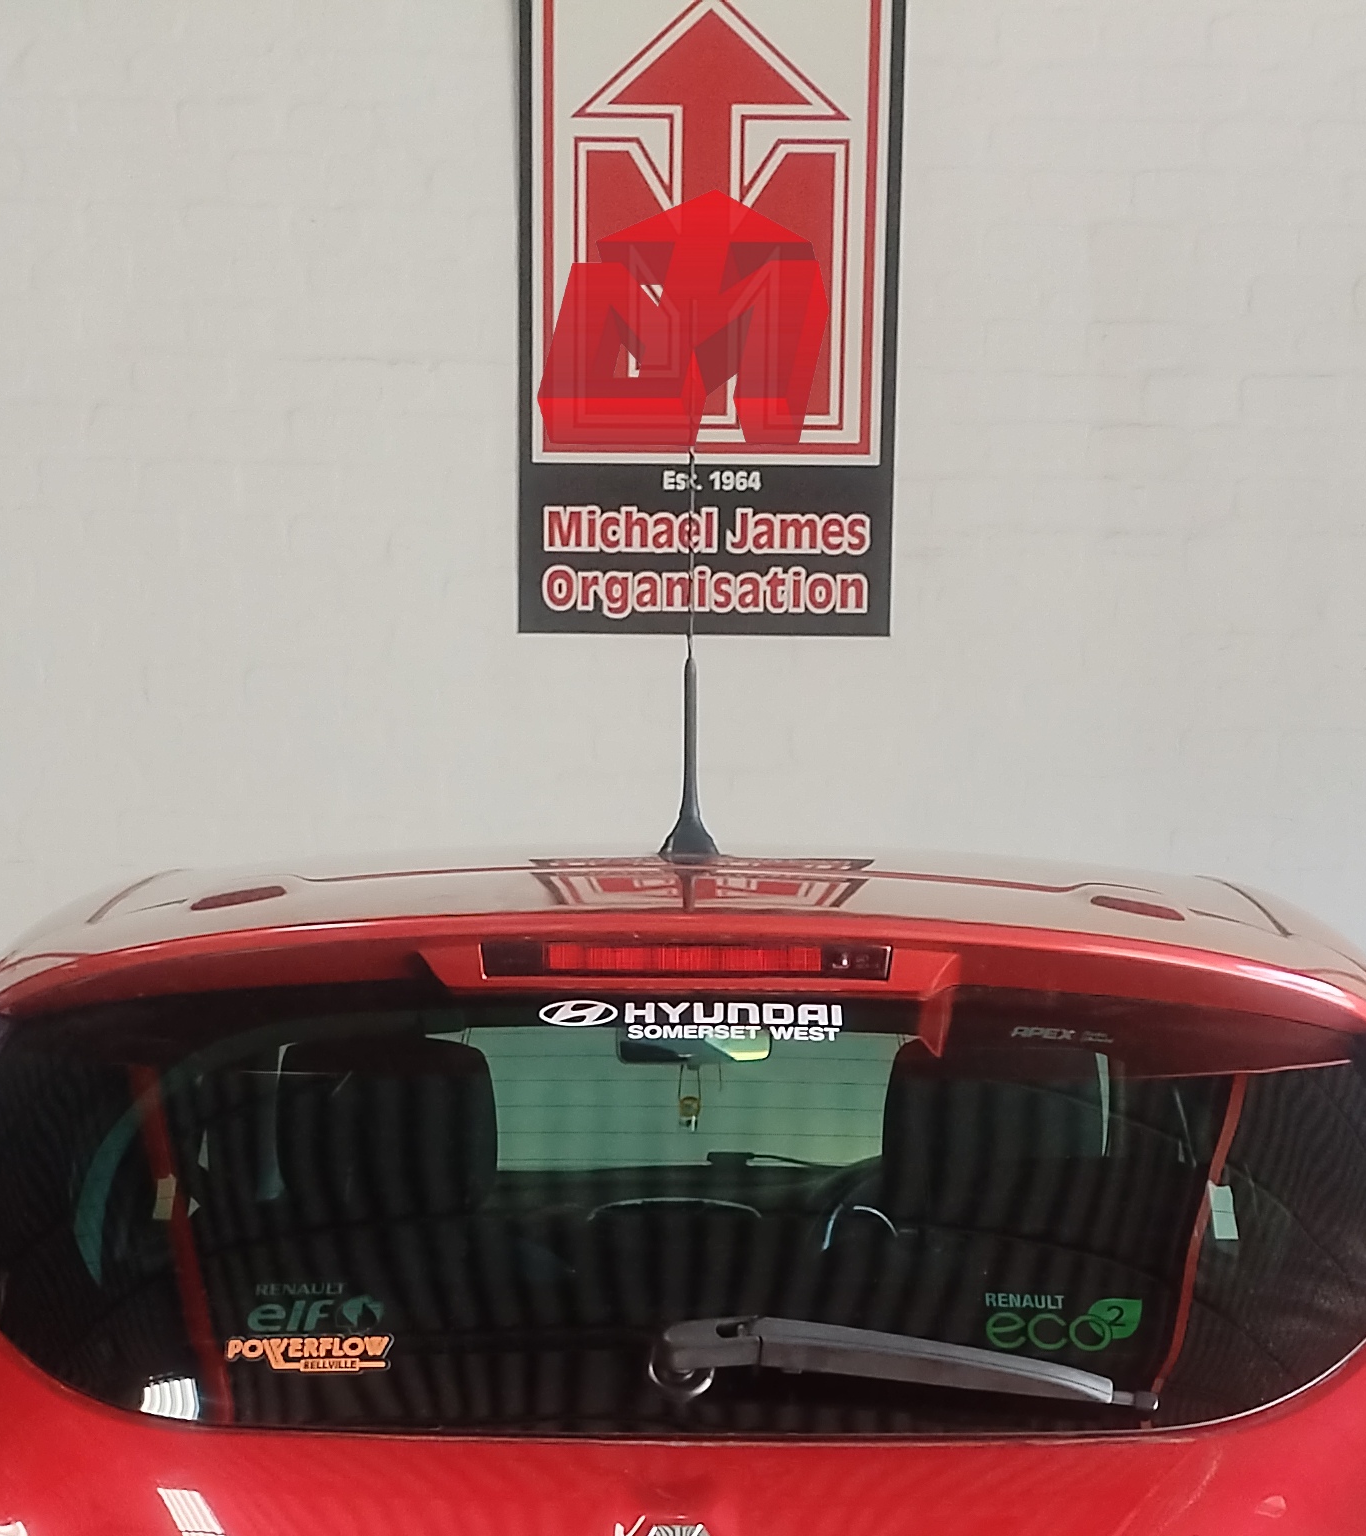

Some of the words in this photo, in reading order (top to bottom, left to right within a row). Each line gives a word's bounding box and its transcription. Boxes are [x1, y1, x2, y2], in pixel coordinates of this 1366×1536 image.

[709, 470, 761, 491] 1964
[543, 505, 718, 554] Michael
[726, 507, 871, 555] James
[543, 564, 868, 619] Organisation
[624, 1002, 843, 1026] HYUNDAI
[627, 1025, 762, 1040] SOMERSET
[770, 1026, 840, 1042] WEST
[1011, 1026, 1073, 1040] APEX
[255, 1282, 347, 1296] RENAULT
[985, 1293, 1064, 1310] RENAULT
[247, 1299, 335, 1332] elf
[227, 1335, 390, 1361] POWERFLOW
